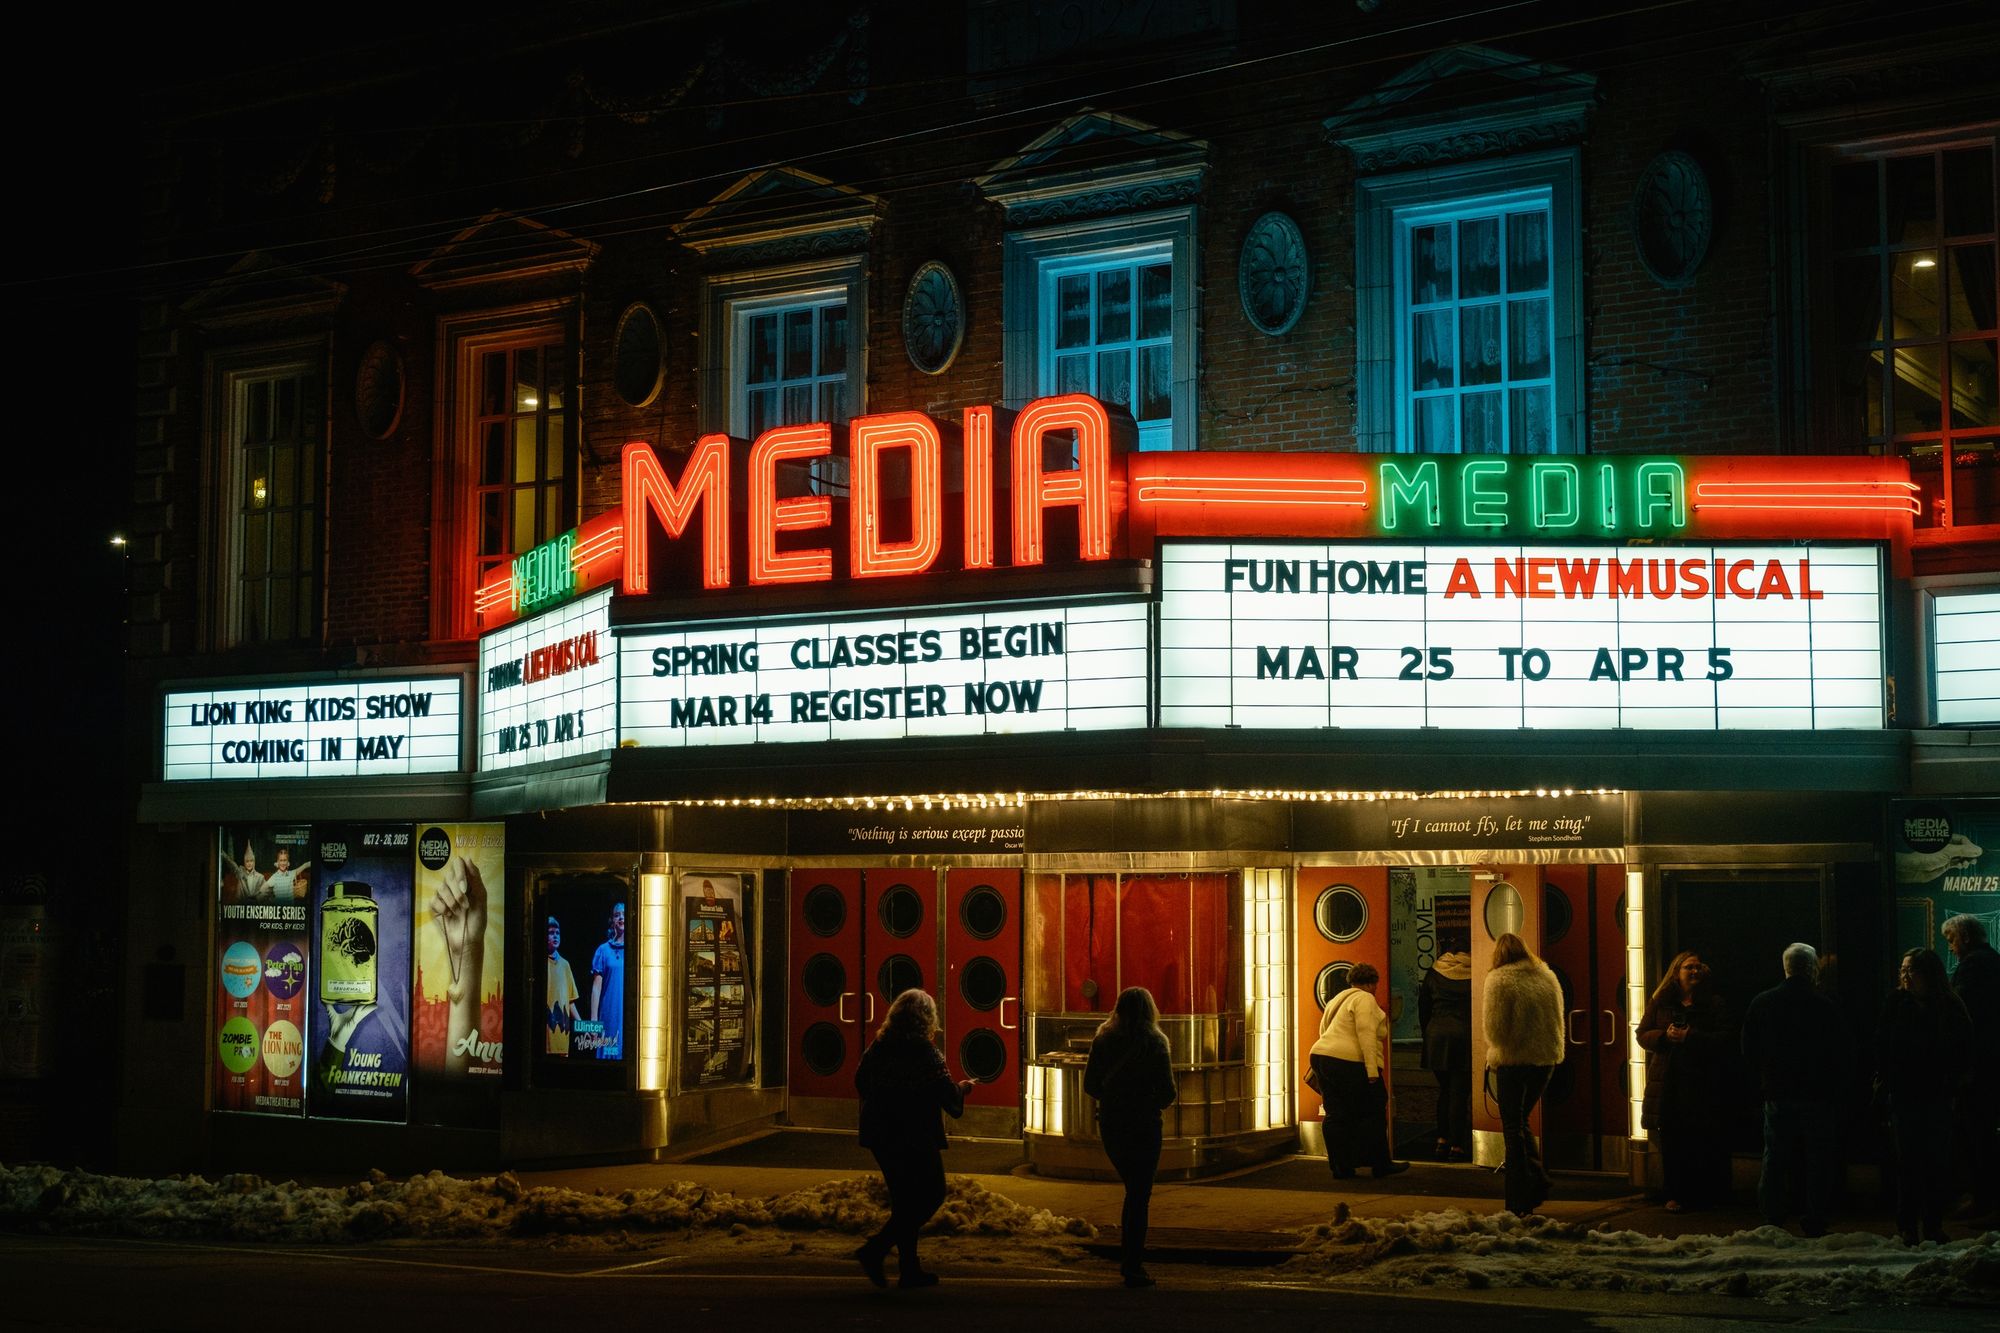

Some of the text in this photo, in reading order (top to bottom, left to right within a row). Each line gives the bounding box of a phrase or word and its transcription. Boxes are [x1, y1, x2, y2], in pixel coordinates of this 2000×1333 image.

[621, 392, 1111, 596] MEDIA
[1380, 461, 1686, 529] MEDIA
[511, 534, 571, 611] MEDIA
[1223, 557, 1824, 600] FUN HOME A NEW MUSICAL
[652, 621, 1065, 678] SPRING CLASSES BEGIN
[1256, 646, 1734, 682] MAR 25 TO APR 5
[191, 692, 432, 727] LION KING KIDS SHOW
[671, 679, 1043, 729] MAR 14 REGISTER NOW
[519, 722, 531, 751] 25
[536, 719, 548, 747] TO
[554, 712, 574, 743] APR
[578, 709, 584, 738] 5
[222, 735, 405, 763] COMING IN MAY
[1391, 815, 1591, 838] "If I cannot fly, let me sing."
[1904, 818, 1949, 829] MEDIA
[363, 834, 375, 845] OCT
[375, 834, 380, 845] 2
[393, 834, 409, 845] 2025
[848, 826, 895, 844] "Nothing
[899, 826, 908, 840] is
[911, 826, 949, 840] serious
[952, 827, 986, 843] except
[1905, 829, 1950, 838] THEATRE
[321, 843, 347, 851] MEDIA
[420, 840, 449, 850] MEDIA
[420, 849, 449, 857] THEATRE
[1943, 876, 1999, 891] MARCH 25
[223, 905, 306, 921] YOUTH ENSEMBLE SERIES
[271, 923, 283, 931] KIDS,
[1416, 897, 1435, 973] COME
[266, 959, 286, 970] Peter
[574, 1020, 603, 1032] Winter
[222, 1033, 252, 1045] ZOMBIE
[269, 1031, 282, 1040] THE
[264, 1041, 302, 1056] LION KING
